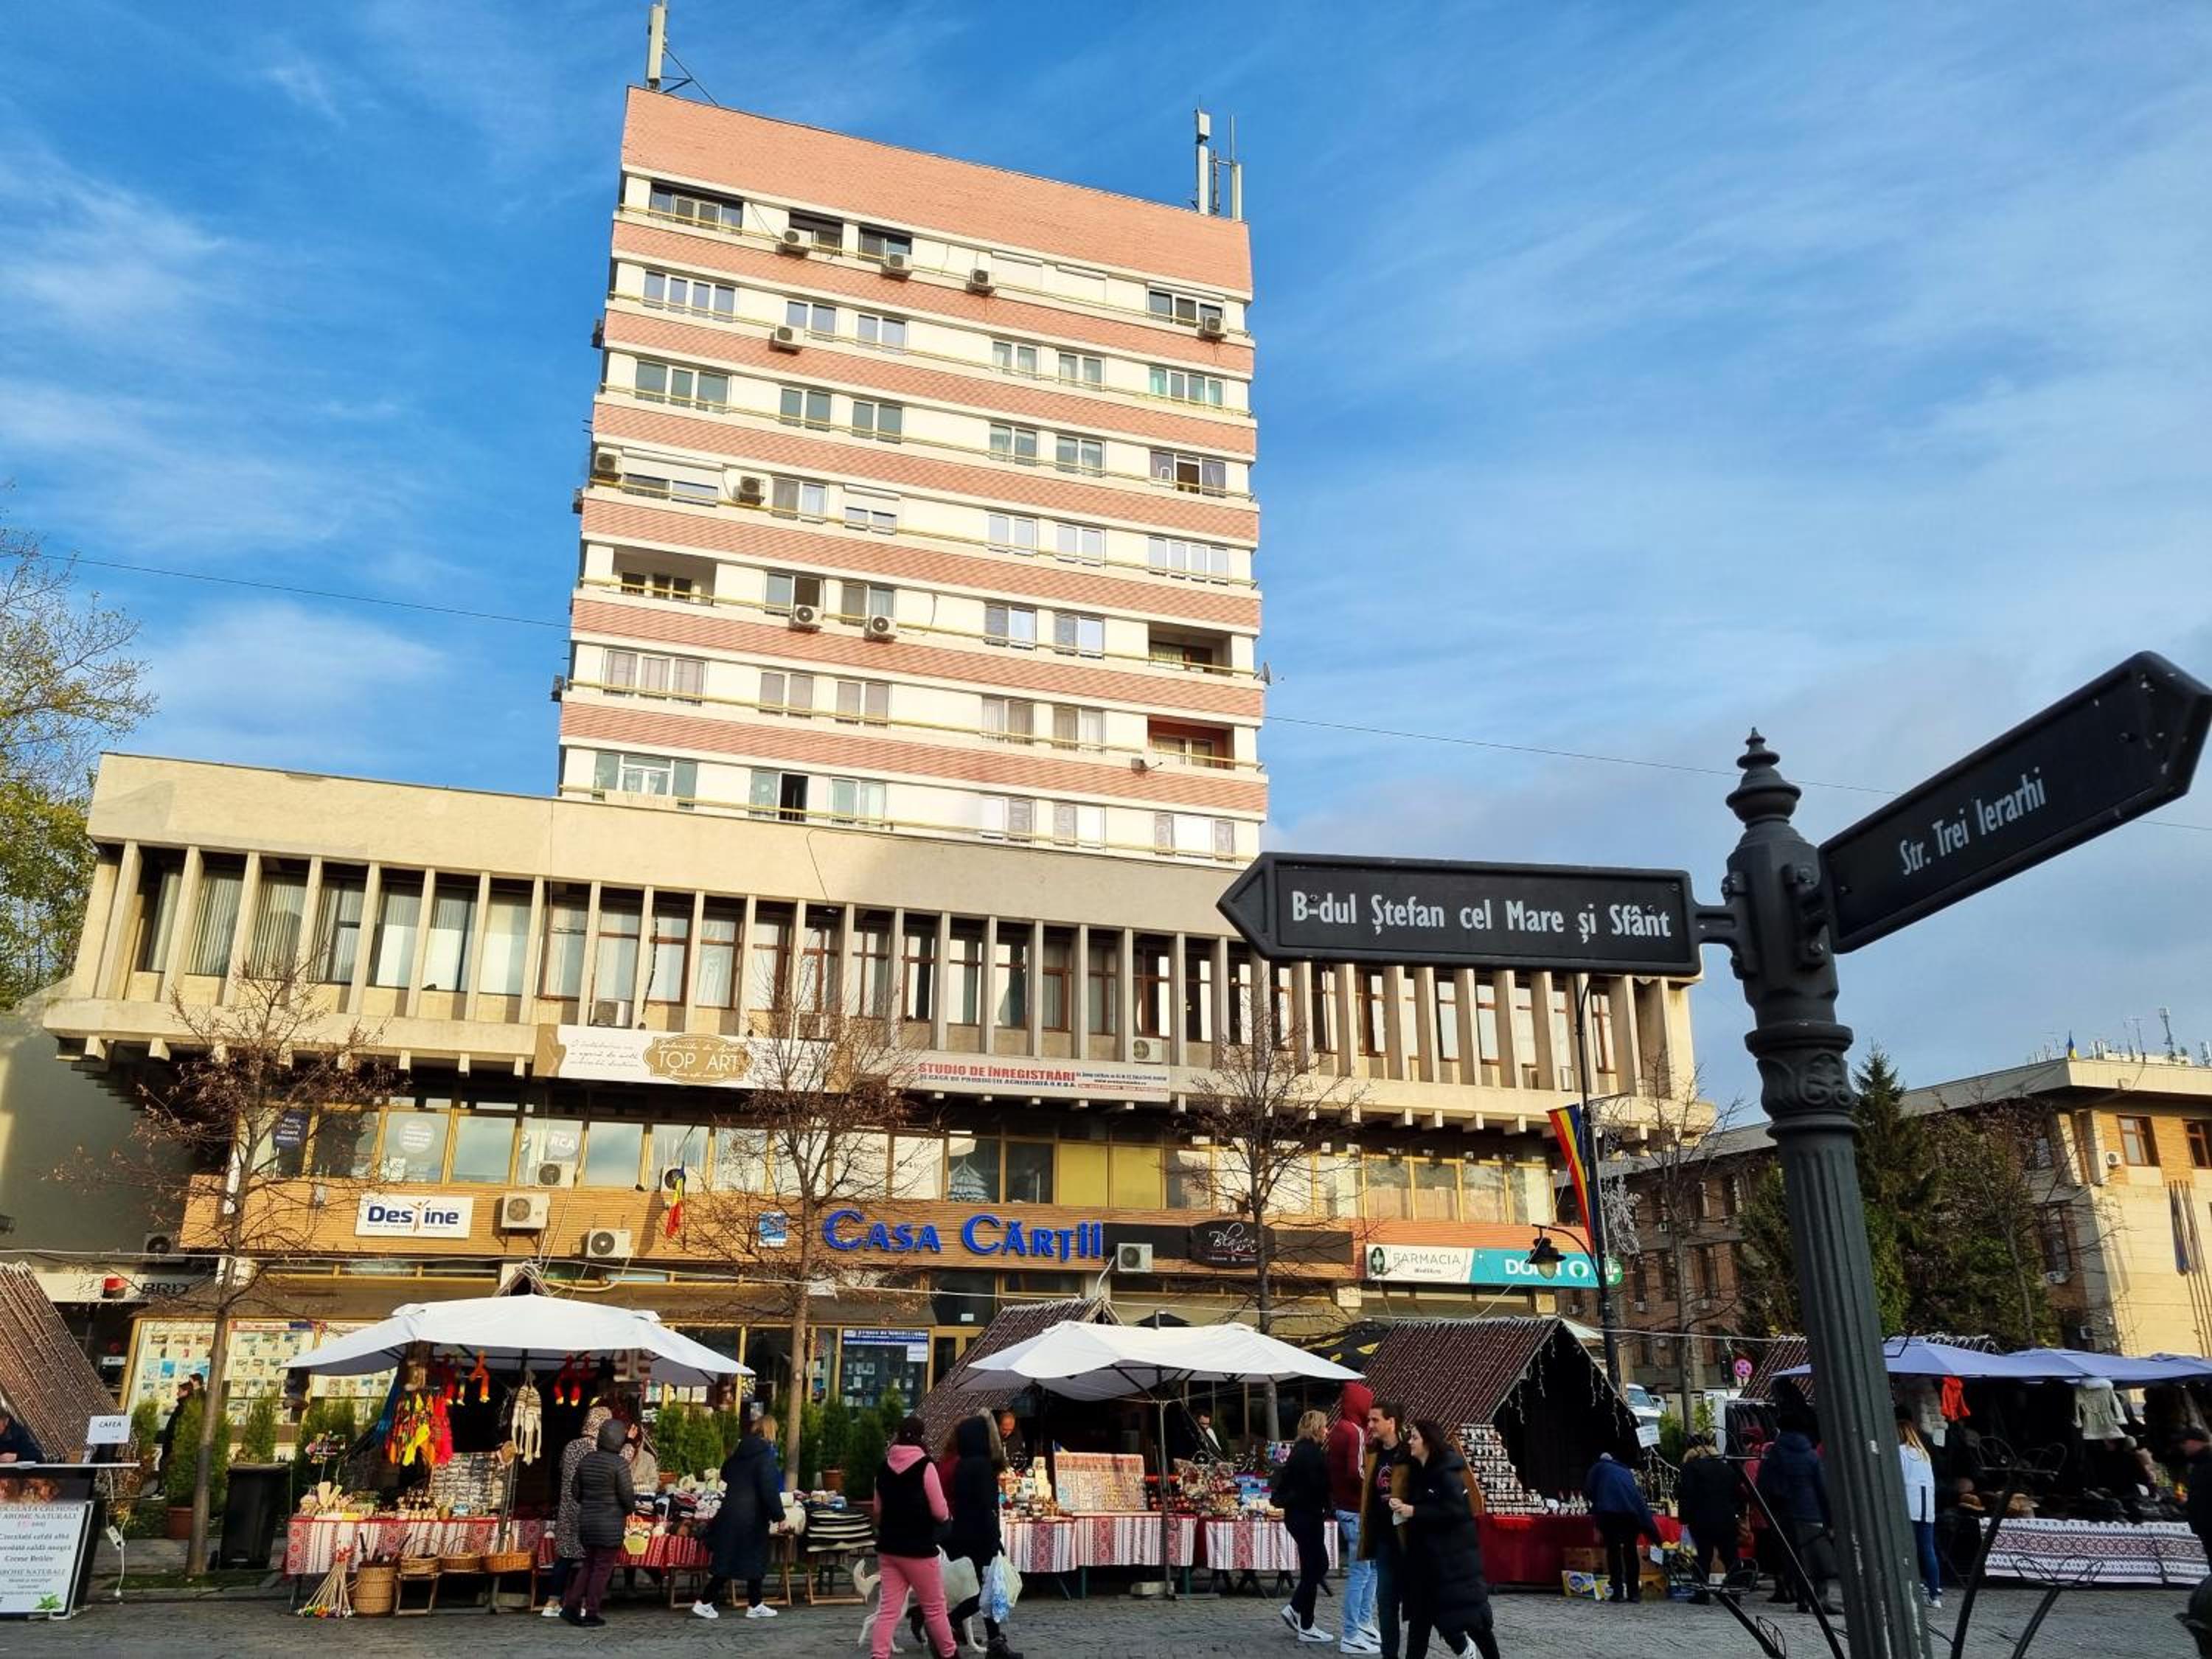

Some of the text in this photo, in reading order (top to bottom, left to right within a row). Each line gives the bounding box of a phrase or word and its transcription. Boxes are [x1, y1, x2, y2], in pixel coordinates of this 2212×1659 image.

[1899, 766, 2046, 875] Str. Trei Ierarhi
[1292, 890, 1672, 943] B-dul Ștefan cel Mare și Sfânt
[657, 1050, 739, 1073] TOP ART
[919, 1062, 967, 1076] STUDIO
[970, 1065, 986, 1077] DE
[821, 1208, 942, 1252] CASA
[1393, 1253, 1461, 1265] FARMACIA
